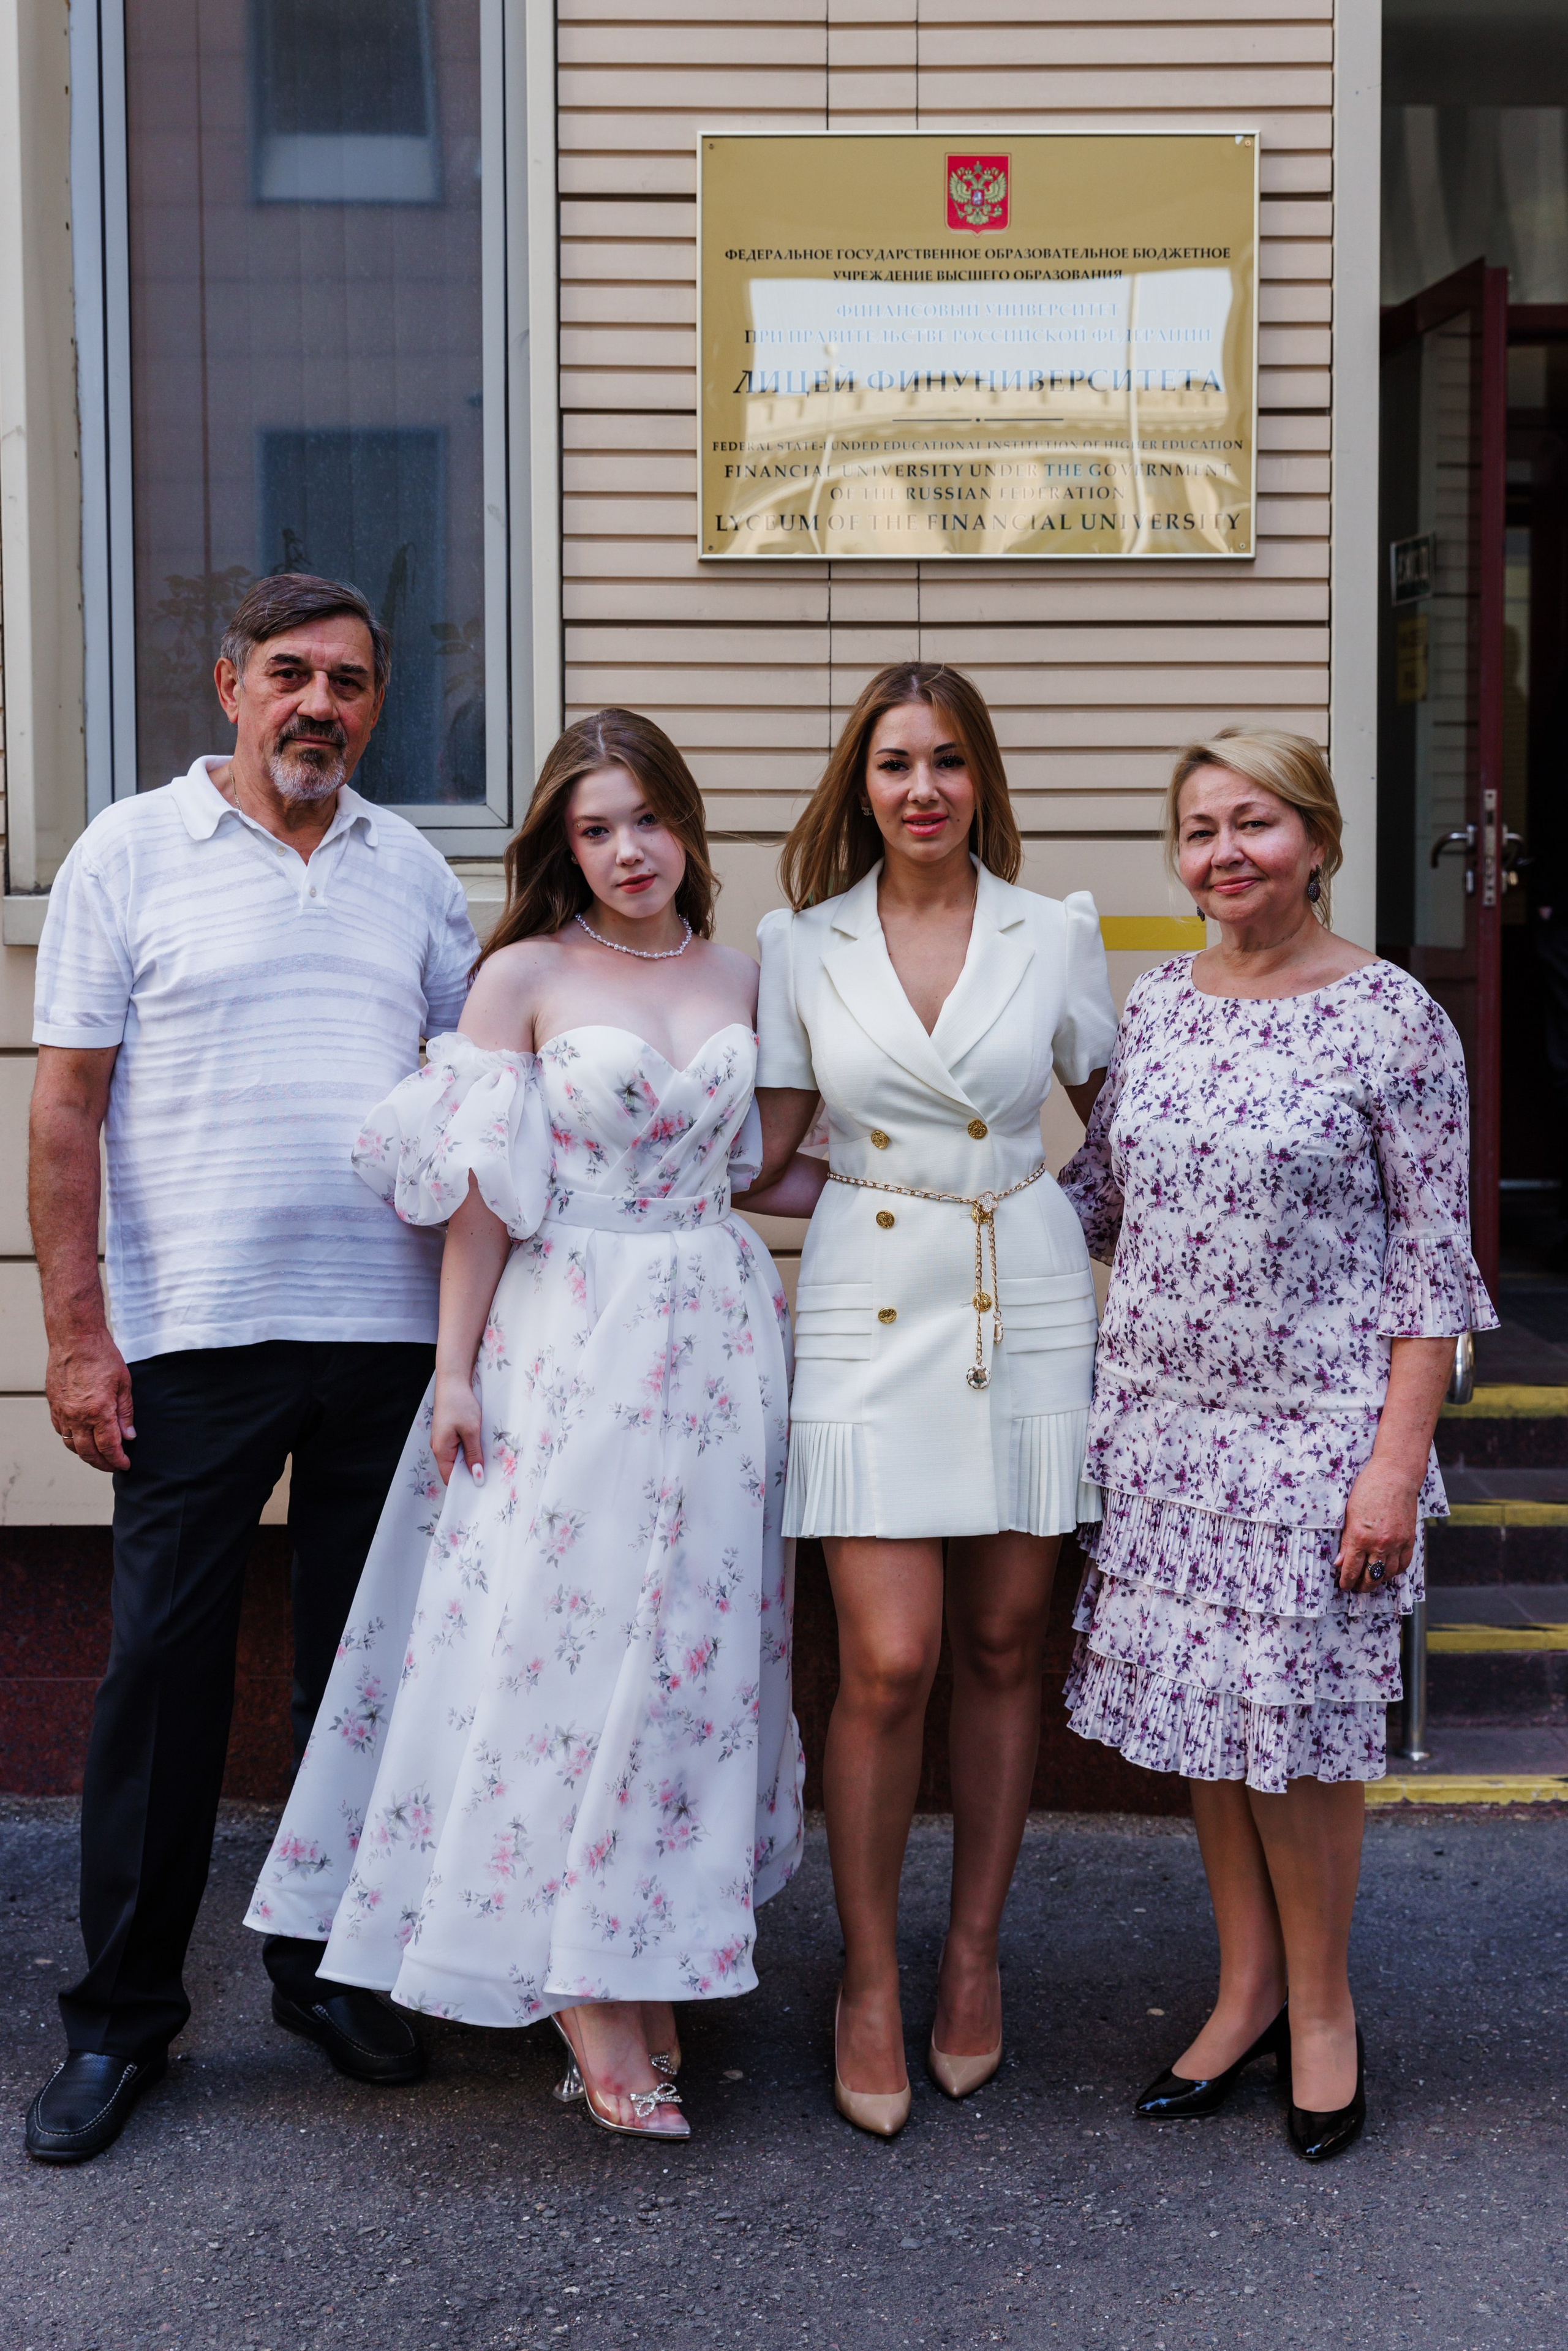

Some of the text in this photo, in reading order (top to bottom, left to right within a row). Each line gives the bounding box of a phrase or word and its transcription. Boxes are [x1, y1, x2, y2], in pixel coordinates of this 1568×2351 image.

[725, 247, 1231, 262] ФЕДЕРАЛЬНОЕ ГОСУДАРСТВЕННОЕ ОБРАЗОВАТЕЛЬНОЕ БЮДЖЕТНОЕ
[833, 269, 1123, 282] УЧРЕЖДЕНИЕ ВЫСШЕГО ОБРАЗОВАНИЯ
[836, 300, 1120, 317] ФИНАНСОВЫЙ УНИВЕРСИТЕТ
[744, 325, 1212, 344] ПРИ ПРАВИТЕЛЬСТВЕ РОССИЙСКОЙ ФЕДЕРАЦИИ
[732, 364, 1223, 397] ЛИЦЕЙ ФИНУНИВЕРСИТЕТА
[712, 441, 774, 451] FEDERAL
[884, 440, 981, 450] EDUCATIONAL
[987, 440, 1079, 450] INSTITUTION
[1083, 440, 1101, 450] OF
[1104, 440, 1158, 450] HIGHER
[1162, 440, 1244, 450] EDUCATION
[725, 463, 1232, 478] FINANCIAL UNIVERSITY UNDER THE GOVERNMENT
[830, 486, 1125, 500] OF THE RUSSIAN FEDERATION
[715, 513, 1241, 532] LYCEUM OF THE FINANCIAL UNIVERSITY
